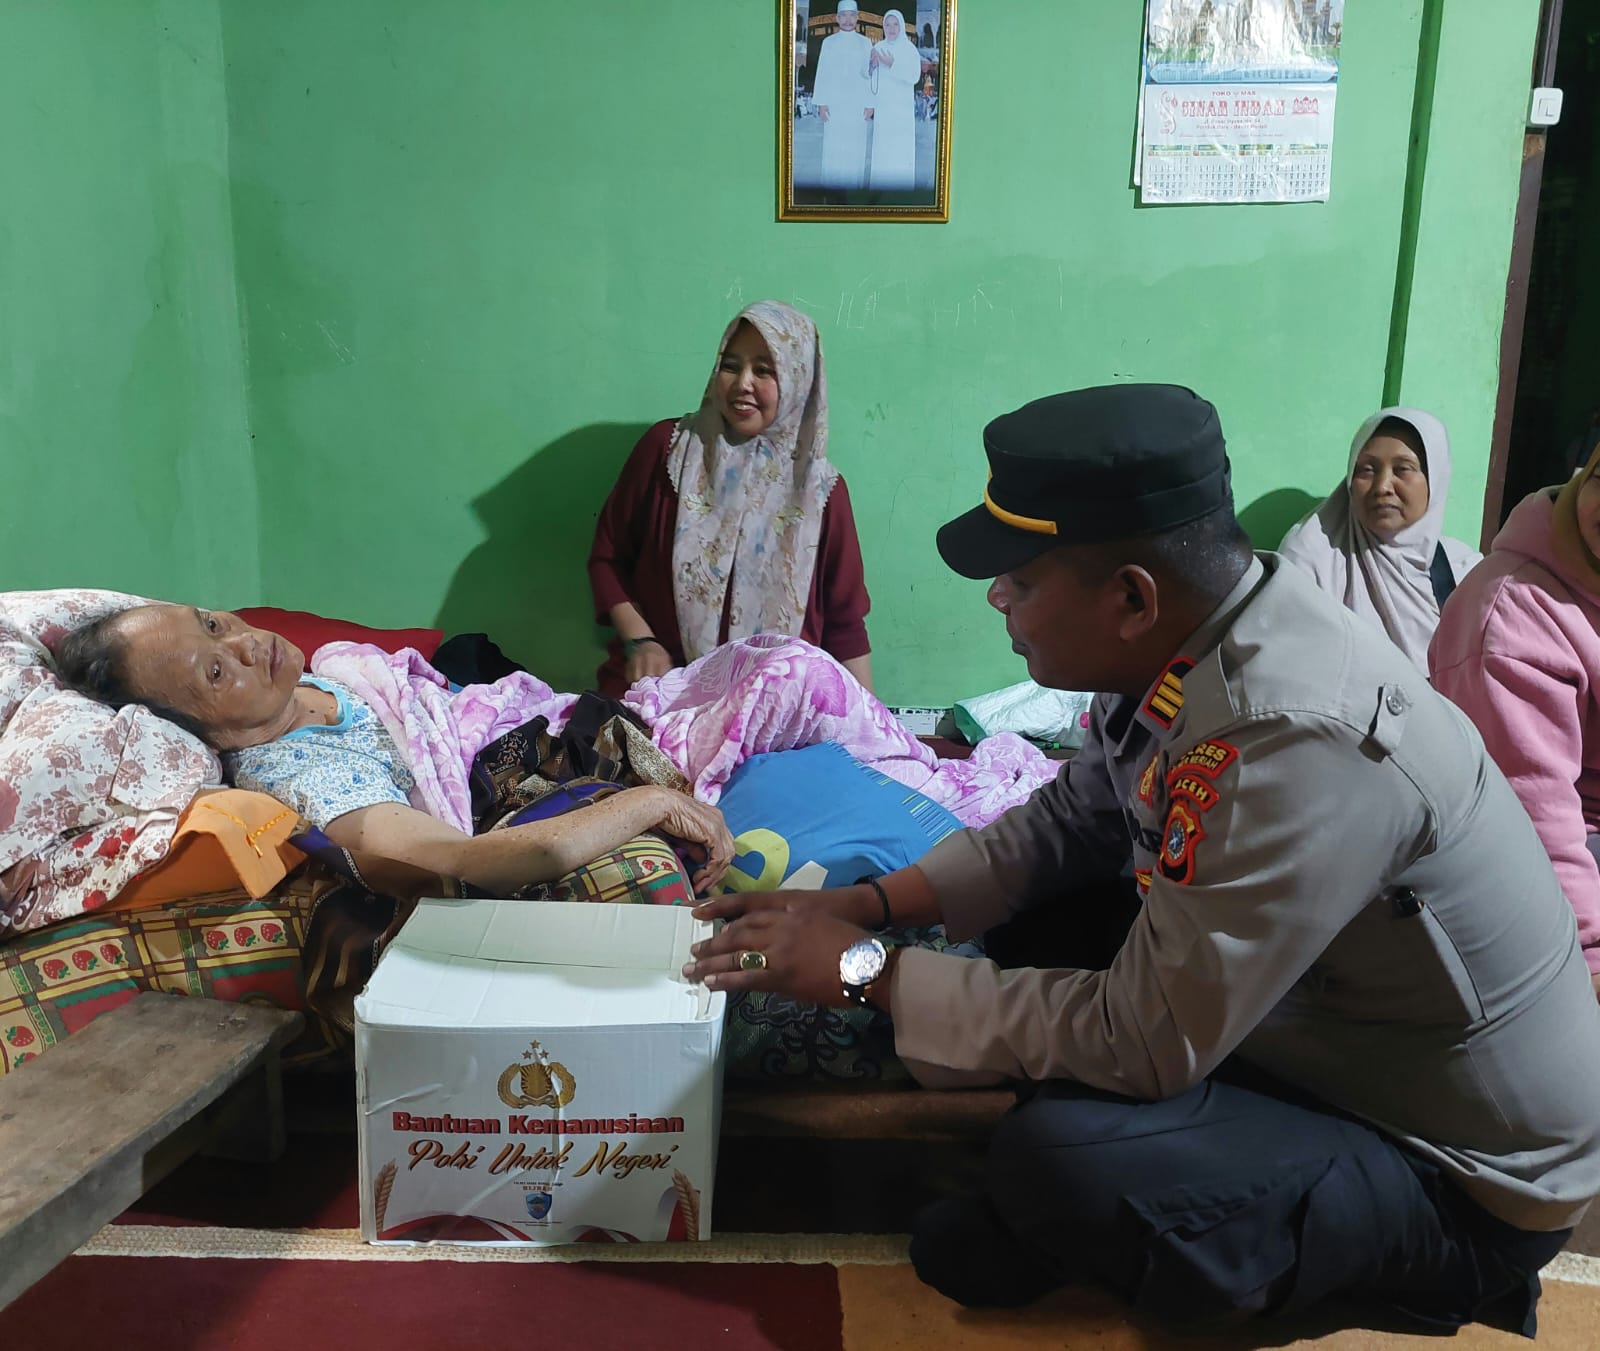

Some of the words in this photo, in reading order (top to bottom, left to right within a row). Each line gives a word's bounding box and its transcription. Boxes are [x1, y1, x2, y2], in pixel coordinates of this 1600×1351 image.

[1175, 778, 1208, 800] ACEH
[392, 1111, 501, 1134] Bantuan
[508, 1112, 685, 1135] Kemanusiaan
[407, 1138, 486, 1171] Polri
[488, 1141, 575, 1176] Untuk
[572, 1140, 679, 1179] Negeri
